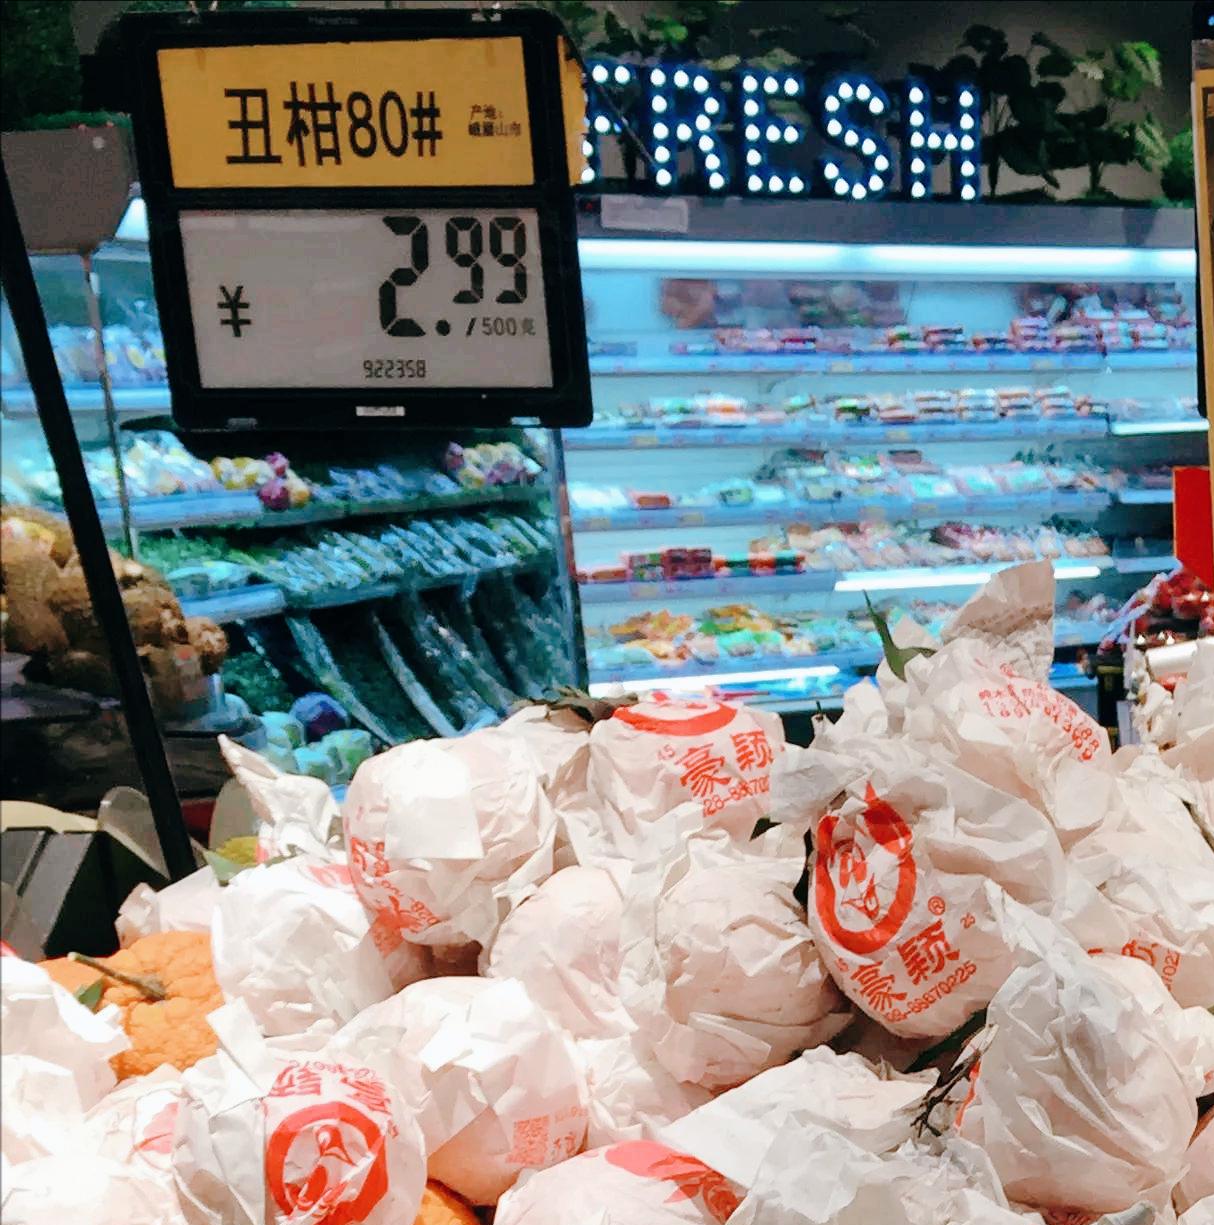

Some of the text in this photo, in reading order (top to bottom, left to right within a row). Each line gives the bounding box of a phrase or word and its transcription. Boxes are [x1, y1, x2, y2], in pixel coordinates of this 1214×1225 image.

[223, 80, 444, 166] 丑柑80#
[582, 58, 983, 202] FRESH
[379, 215, 529, 338] 2.99
[850, 919, 961, 1013] 豪颖
